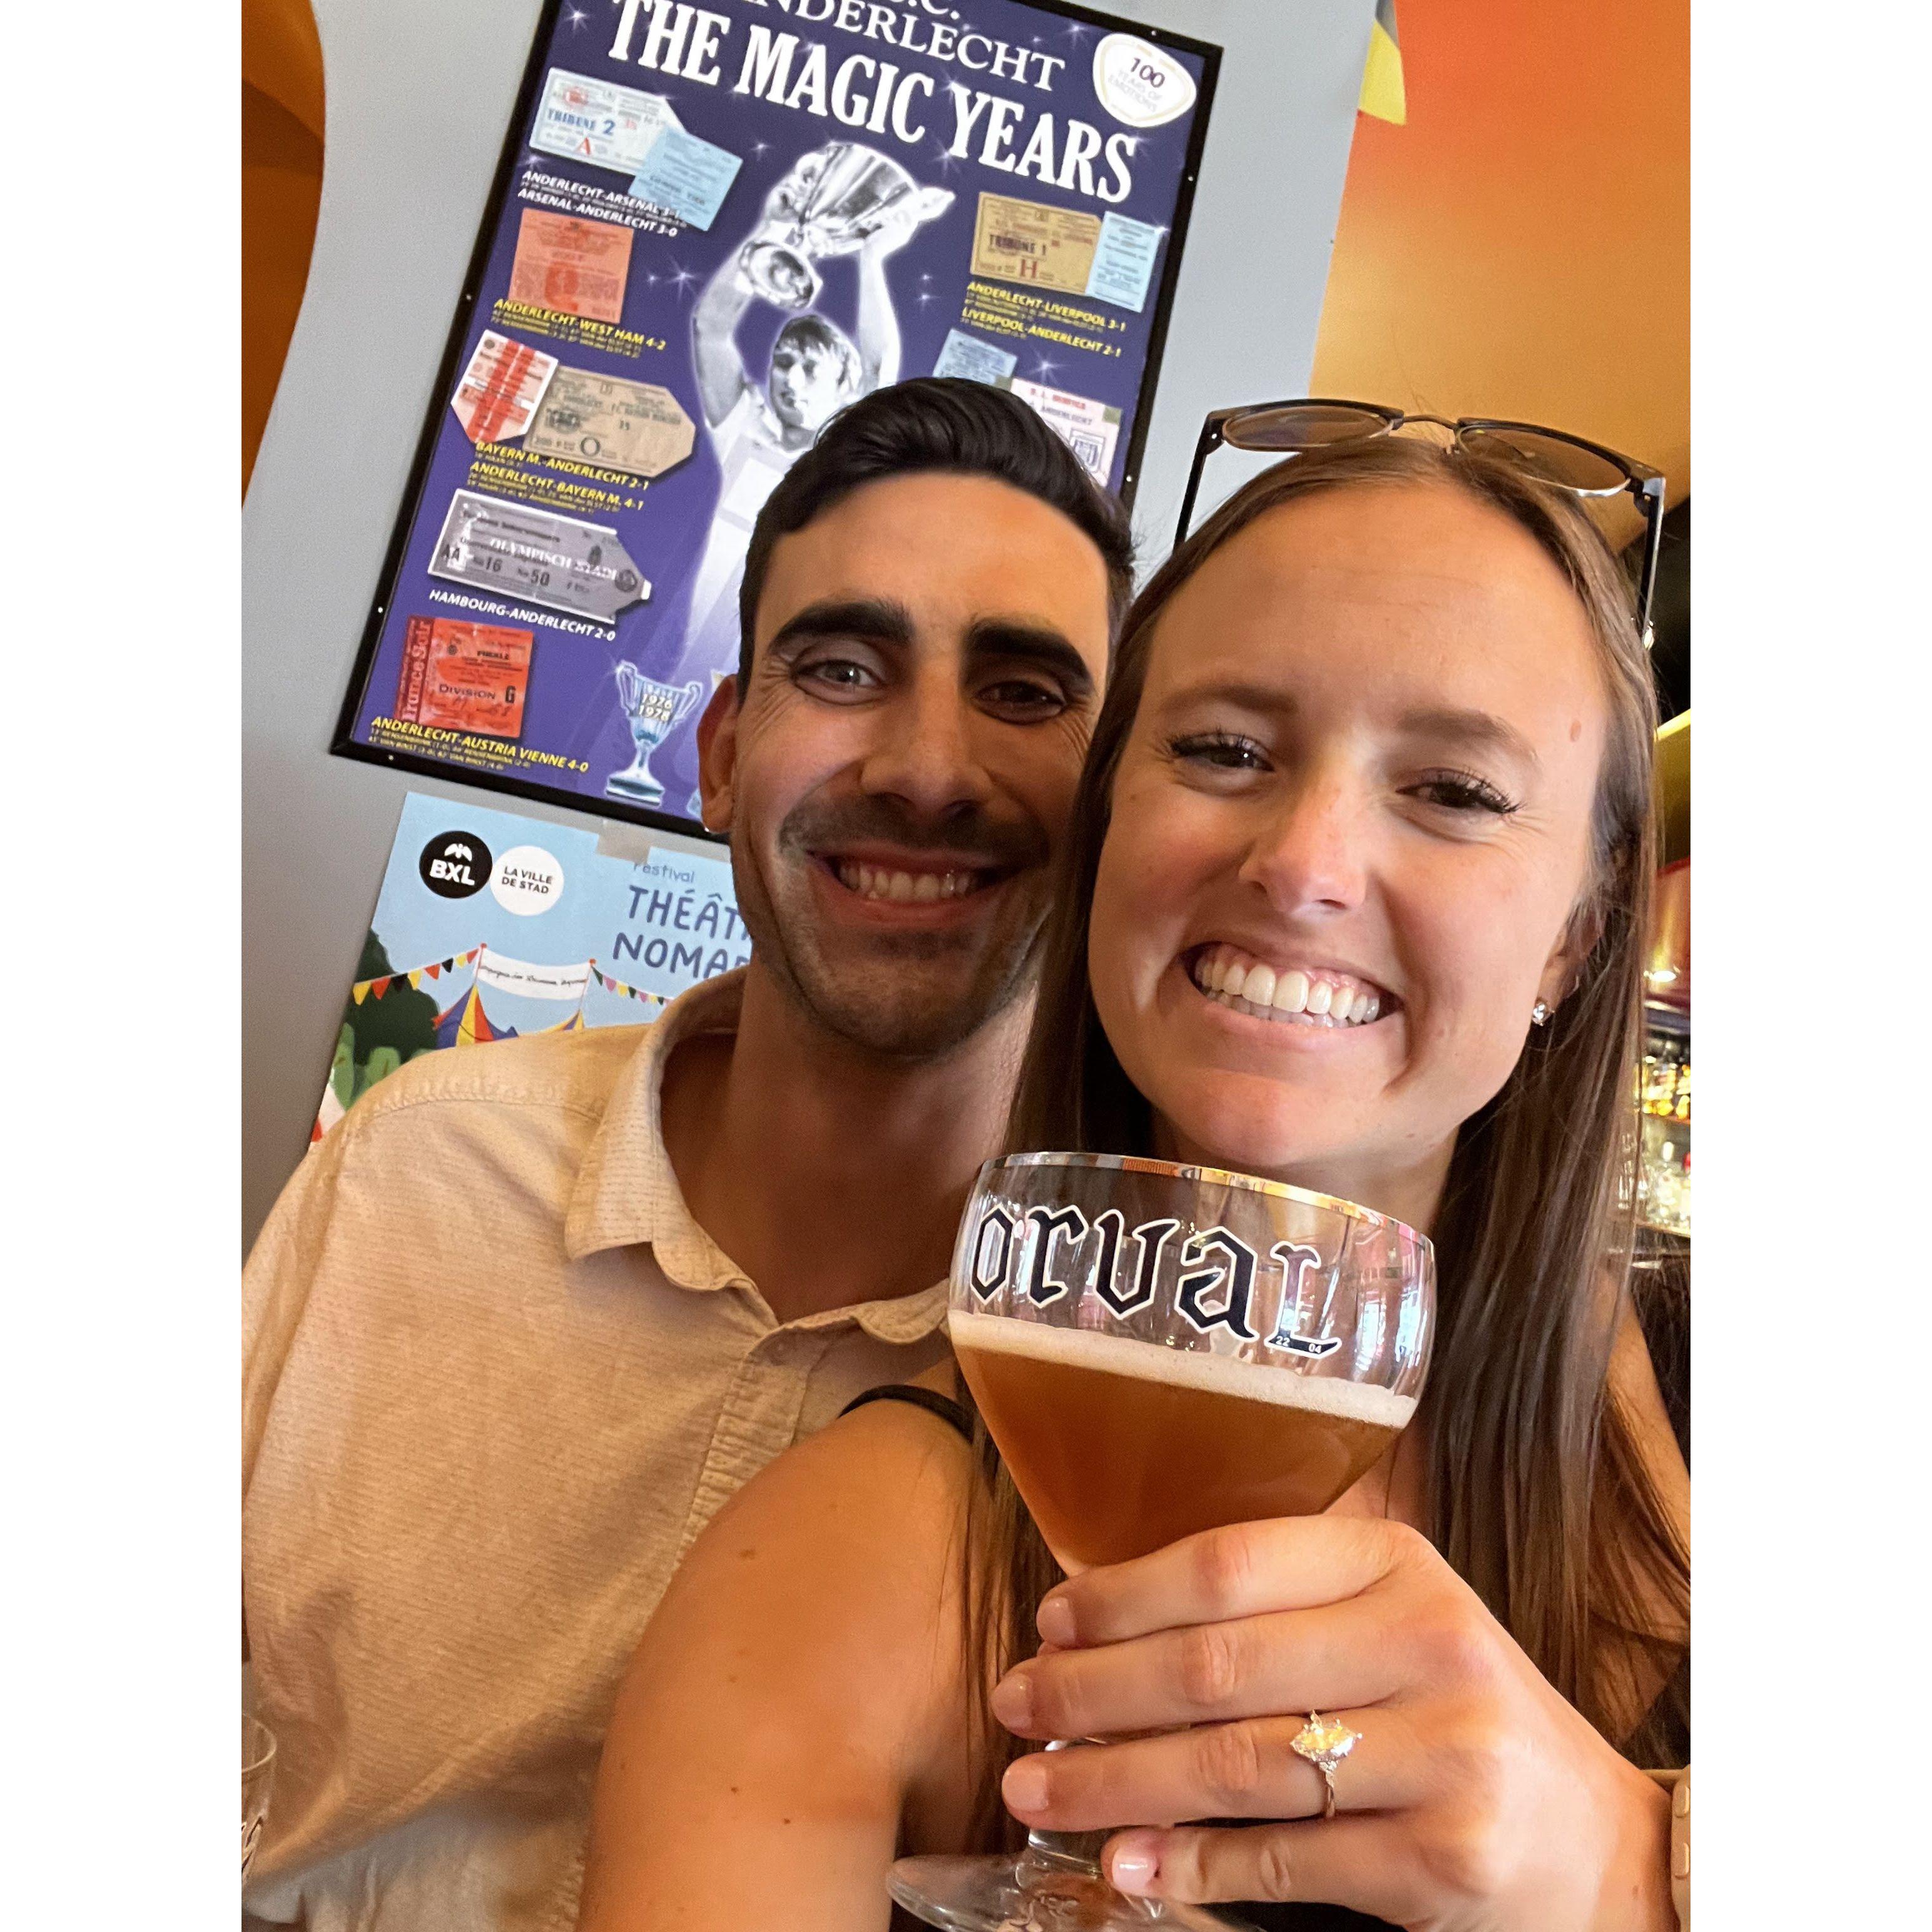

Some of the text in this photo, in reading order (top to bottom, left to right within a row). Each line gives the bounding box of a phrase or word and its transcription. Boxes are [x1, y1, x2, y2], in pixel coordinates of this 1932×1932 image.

[1131, 57, 1166, 88] 100
[608, 0, 1137, 203] THE MAGIC YEARS
[602, 119, 616, 136] 2
[576, 136, 592, 156] A
[522, 170, 663, 214] ANDERLECHT-ARSENAL
[517, 188, 657, 231] ARSENAL-ANDERLECHT
[1020, 258, 1039, 279] H
[967, 282, 1106, 327] ANDERLECHT-LIVERPOOL
[494, 298, 614, 336] ANDERLECHT-WEST
[610, 328, 645, 345] HAM
[962, 306, 1103, 353] LIVERPOOL-ANDERLECHT
[475, 441, 524, 462] BAYERN
[470, 461, 606, 502] ANDERLECHT-BAYERN
[624, 497, 645, 511] 4-1
[429, 589, 594, 637] HAMBOURG-ANDERLECHT
[594, 626, 616, 642] 2-0
[505, 685, 517, 704] G
[371, 716, 517, 758] ANDERLECHT-AUSTRIA
[519, 746, 567, 769] VIENNE
[567, 759, 589, 773] 4-0
[429, 858, 475, 886] BXL
[501, 876, 549, 895] DE STAD
[504, 865, 553, 885] LA VILLE
[1274, 1335, 1323, 1355] 22 04
